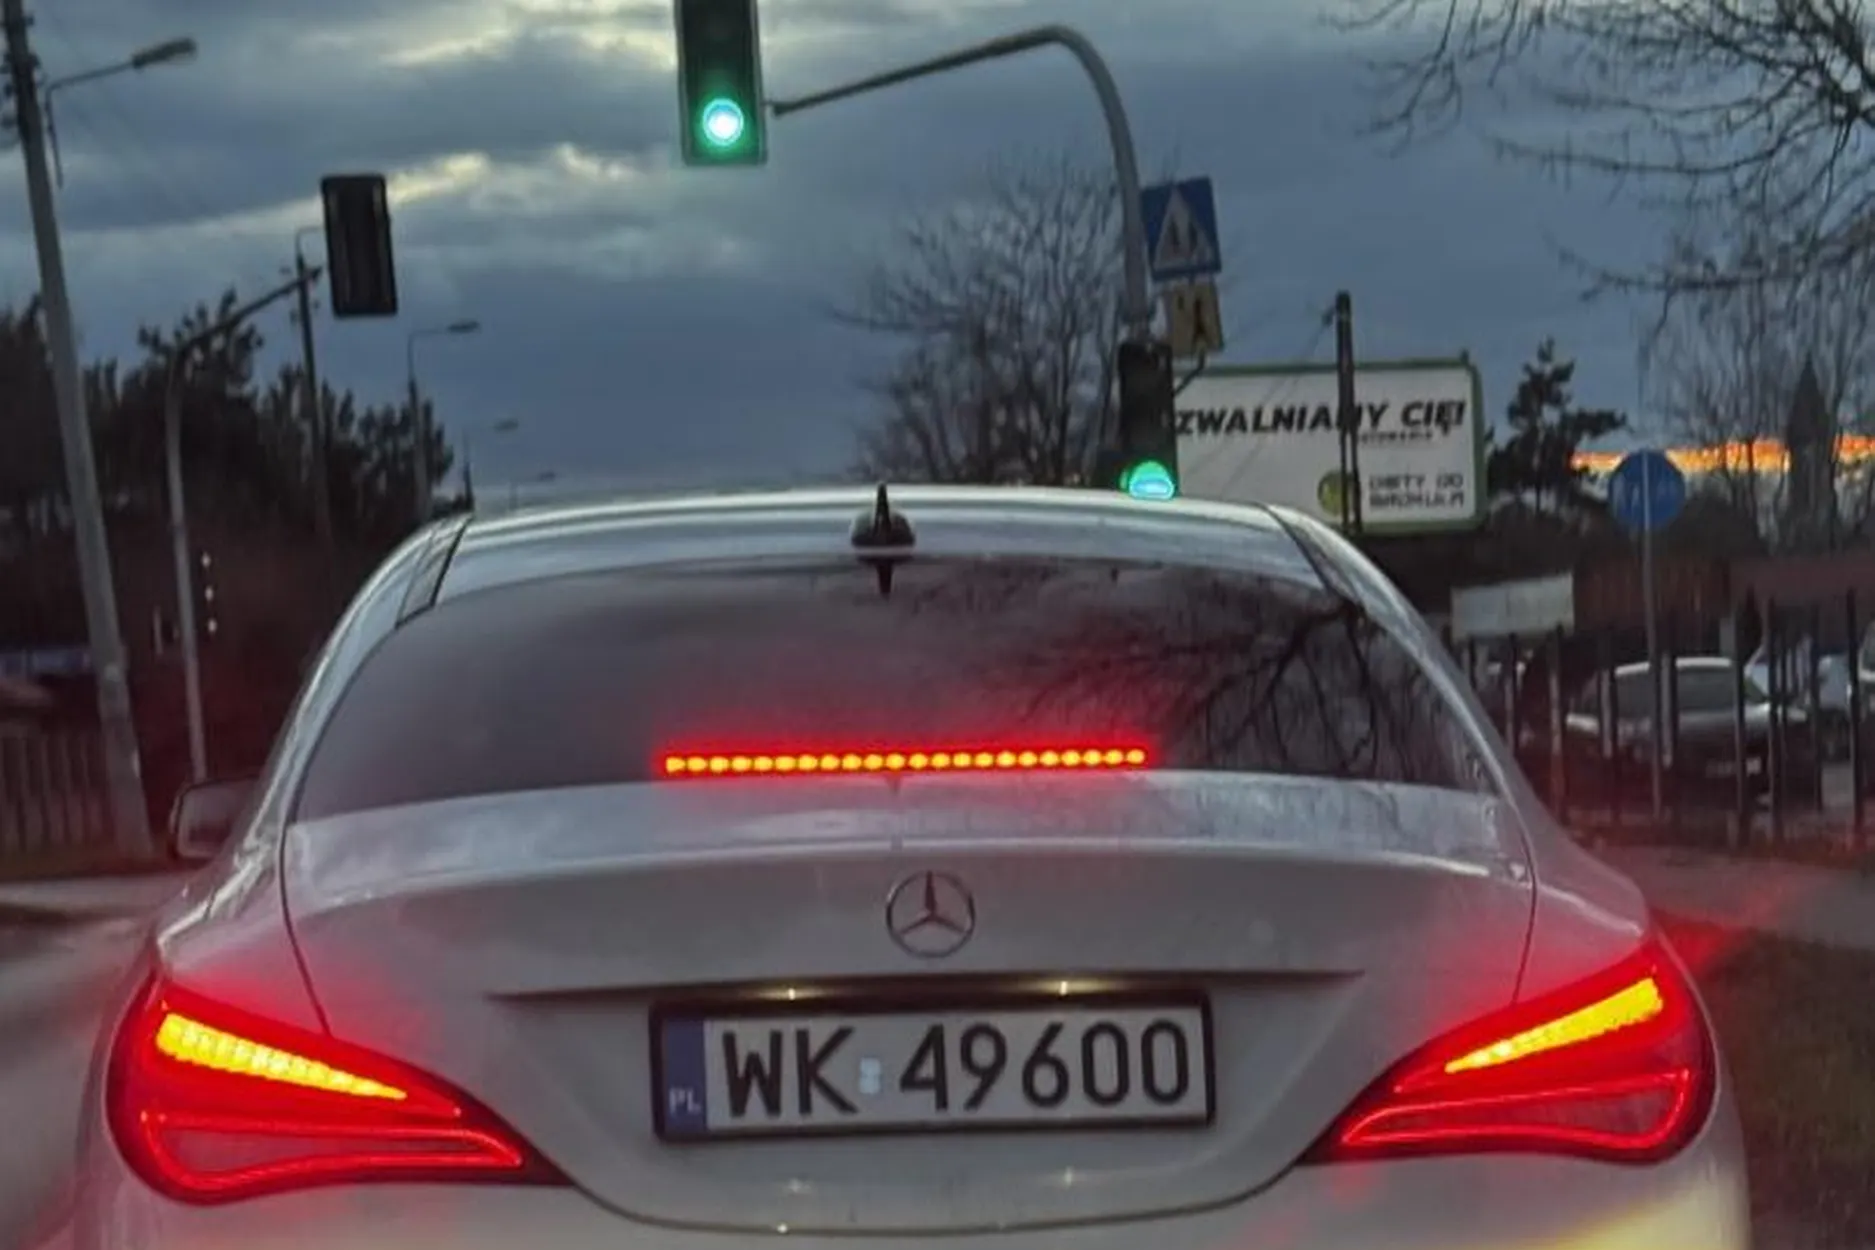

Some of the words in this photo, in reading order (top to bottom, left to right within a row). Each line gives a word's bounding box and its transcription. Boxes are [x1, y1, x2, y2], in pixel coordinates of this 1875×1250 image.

[722, 1026, 858, 1117] WK
[899, 1019, 1189, 1112] 49600
[669, 1088, 702, 1114] PL
